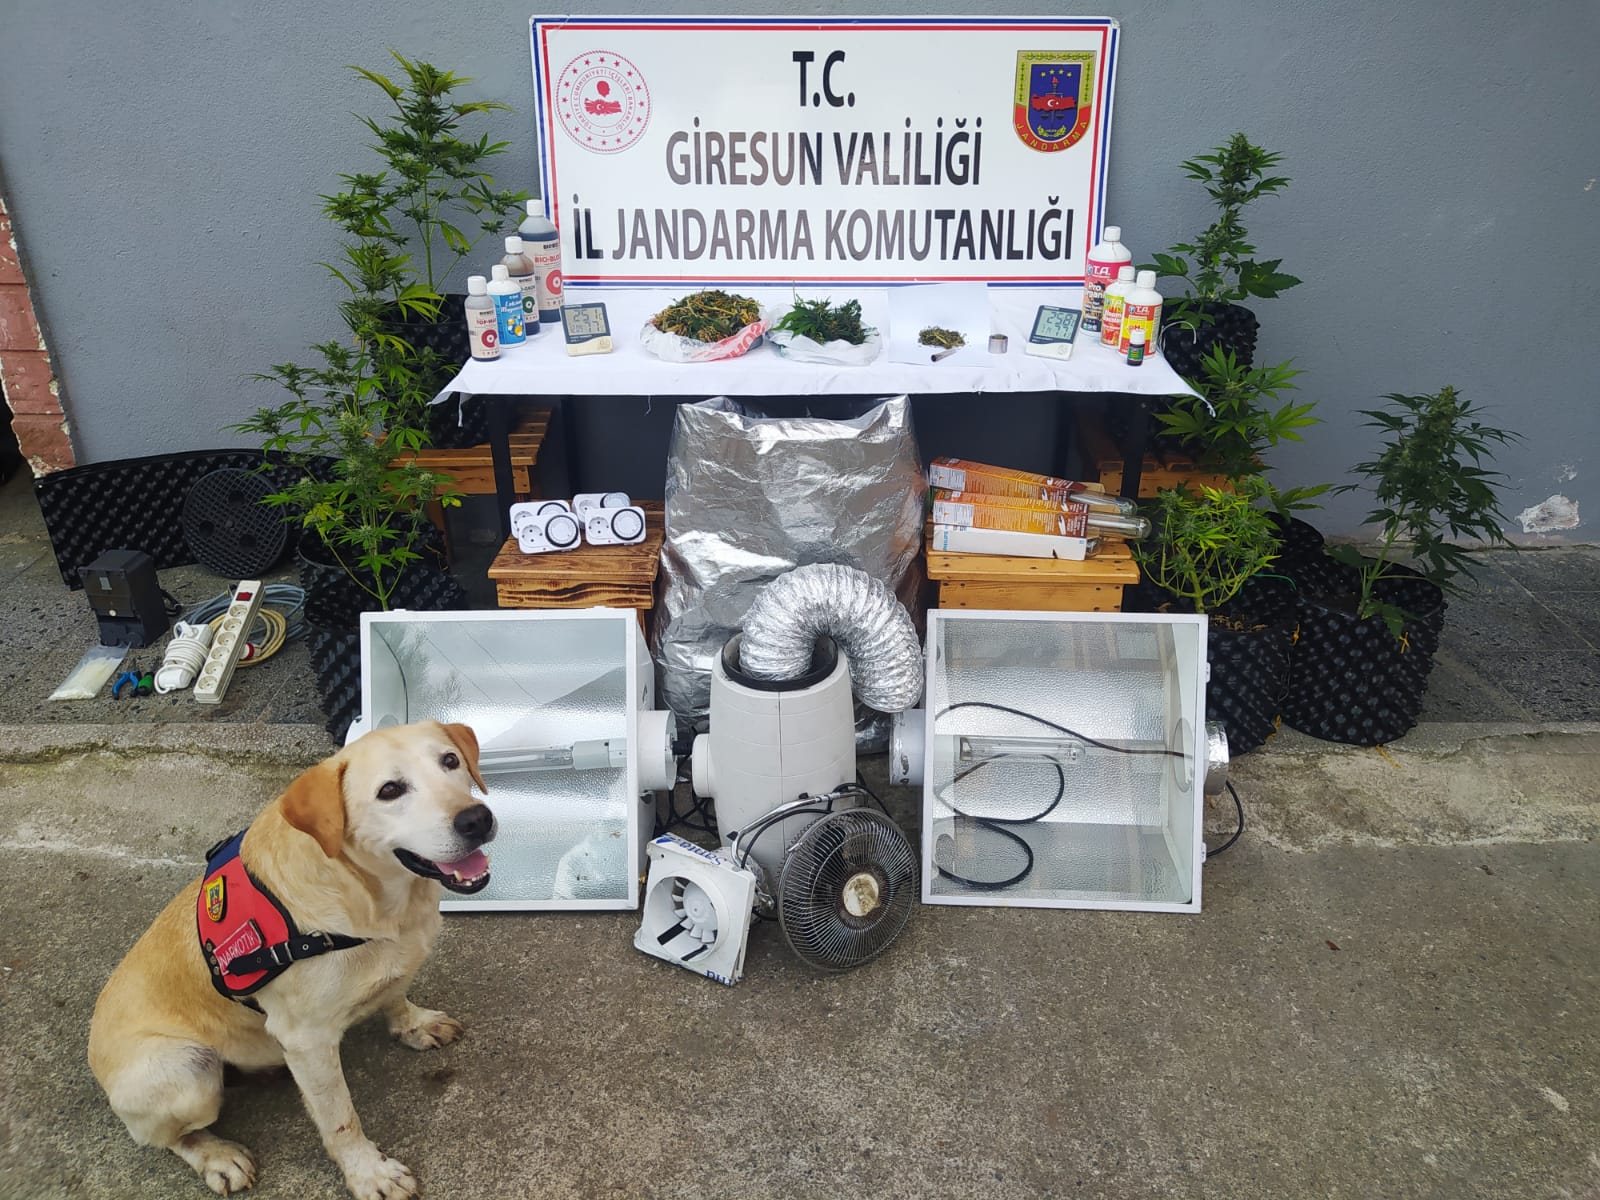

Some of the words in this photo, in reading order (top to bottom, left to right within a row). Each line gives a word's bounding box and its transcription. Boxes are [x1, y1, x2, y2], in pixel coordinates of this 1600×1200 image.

[792, 50, 856, 107] T.C.
[665, 116, 823, 186] GİRESUN
[832, 117, 983, 186] VALİLİĞİ
[1016, 121, 1088, 150] JANDARMA
[572, 193, 604, 259] İL
[612, 208, 815, 260] JANDARMA
[824, 195, 1075, 261] KOMUTANLIĞI
